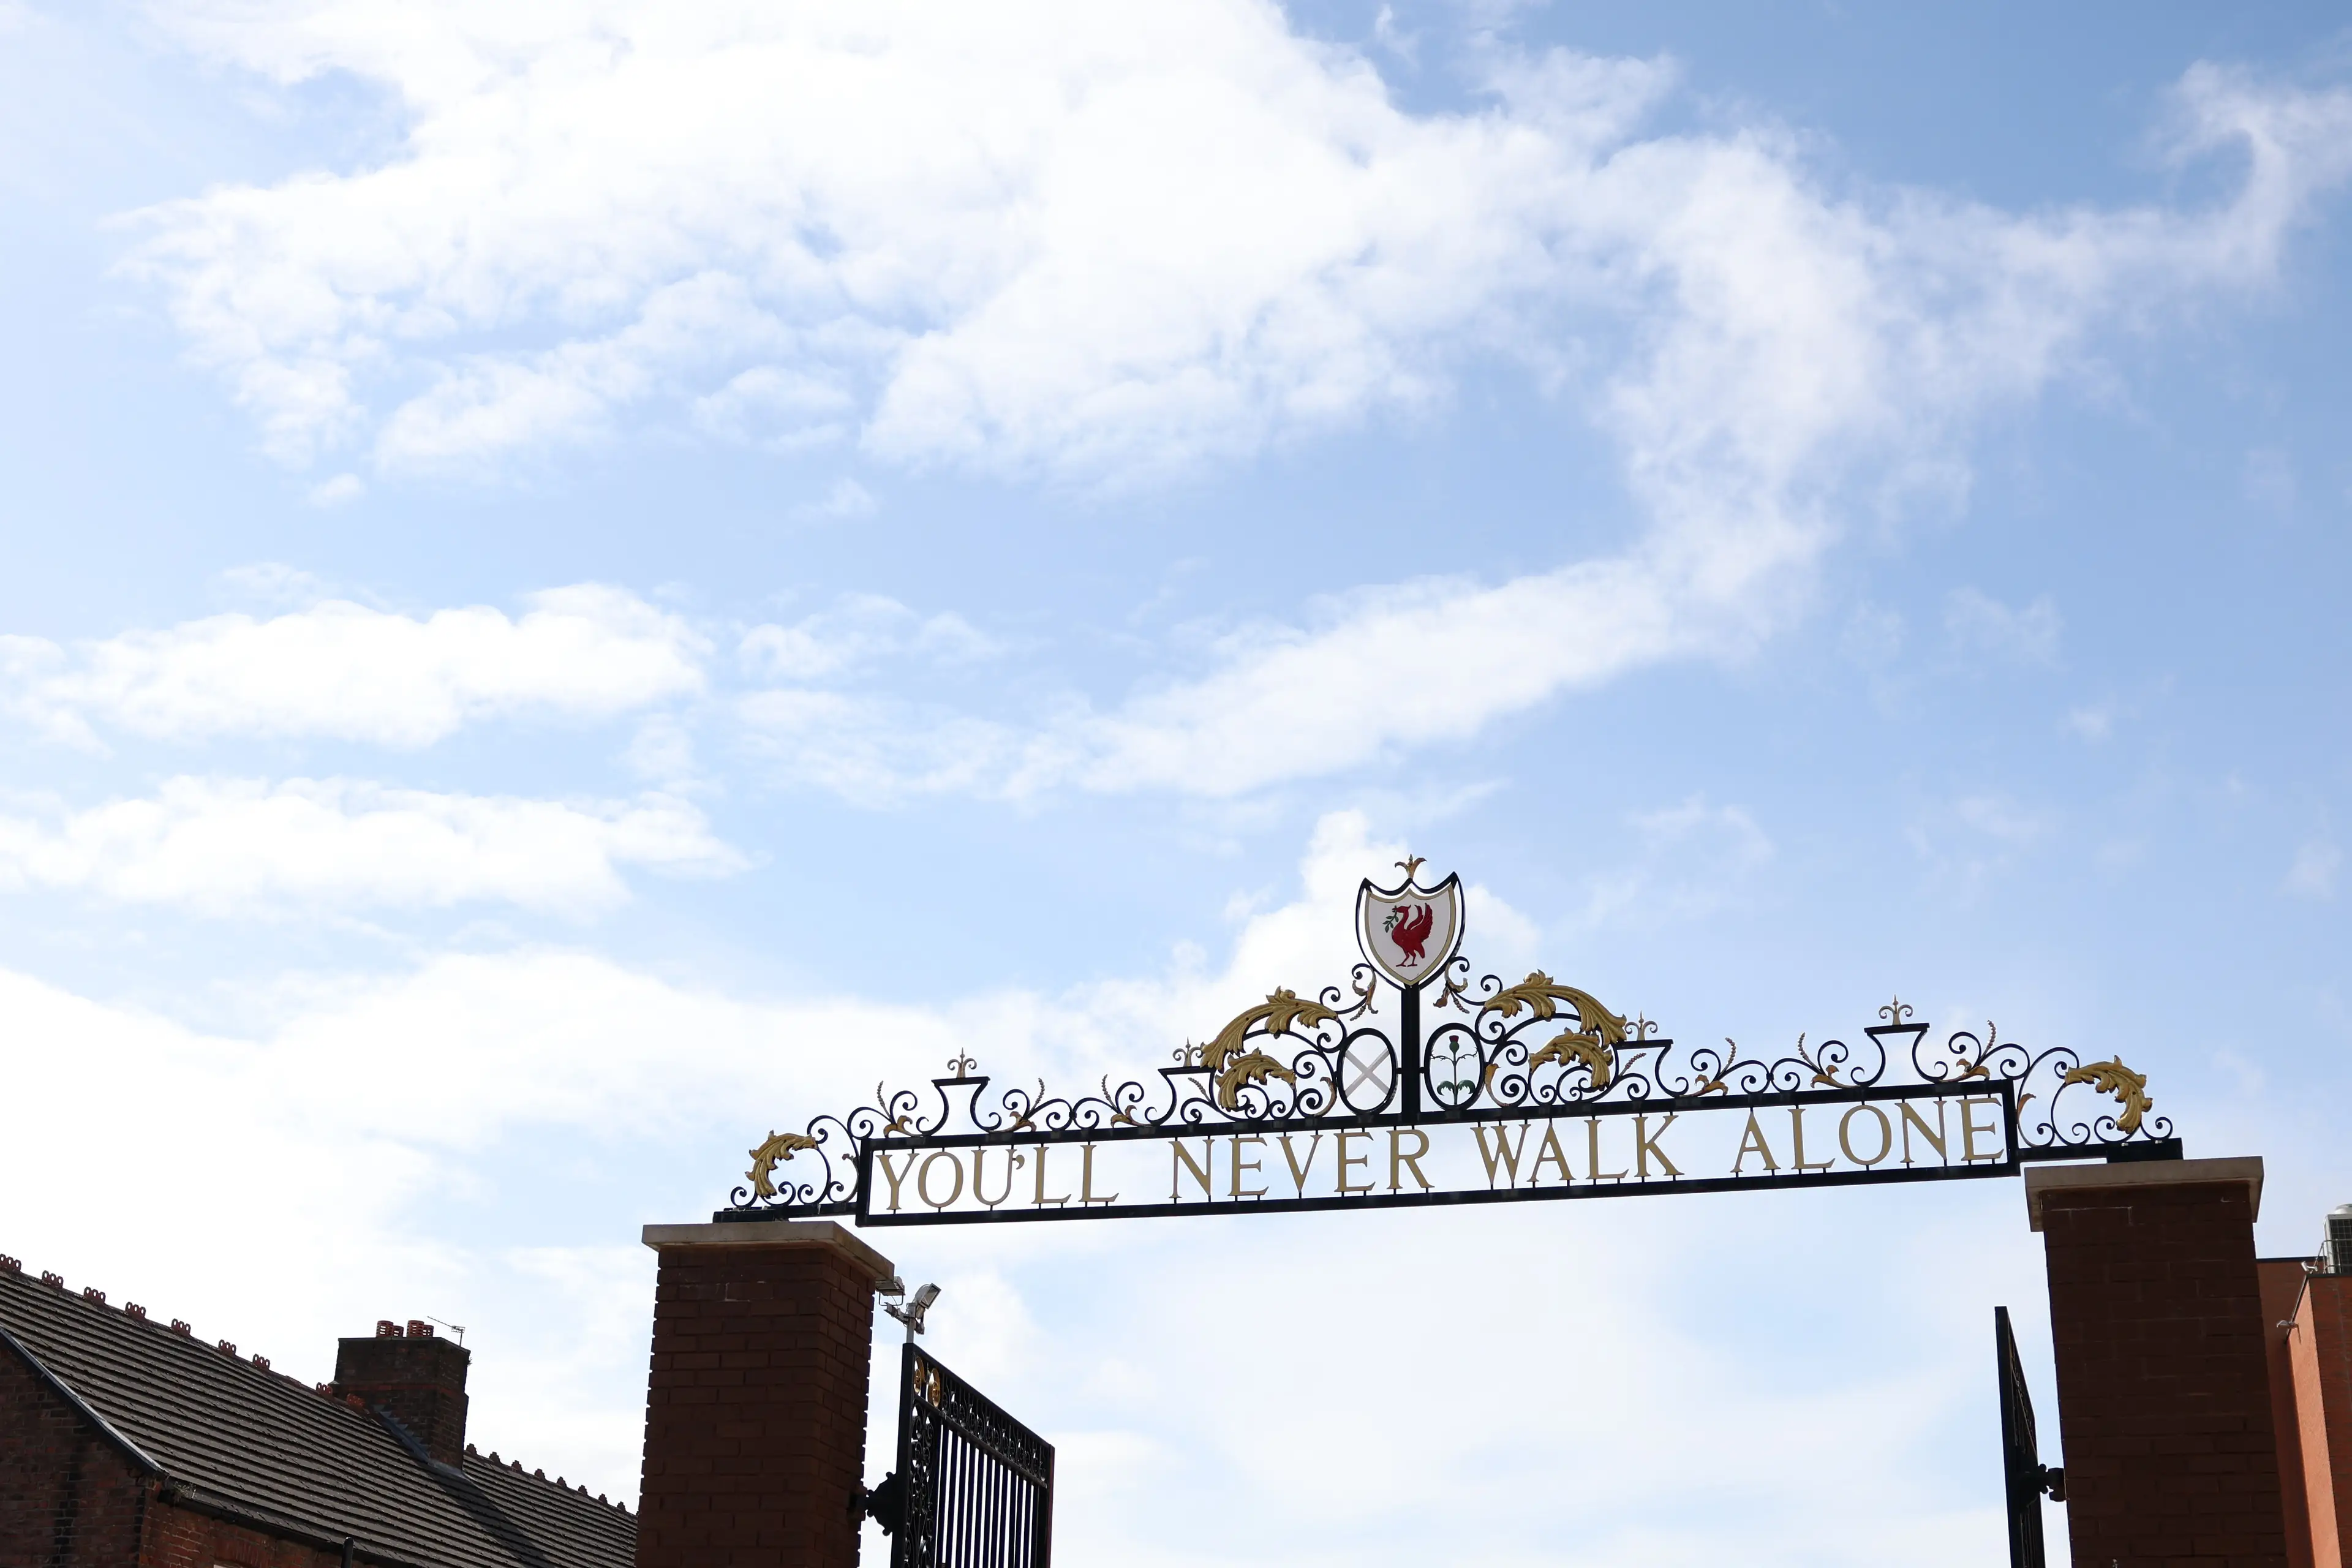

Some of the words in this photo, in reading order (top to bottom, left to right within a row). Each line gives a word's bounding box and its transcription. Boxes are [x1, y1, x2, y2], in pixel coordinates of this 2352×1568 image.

[878, 1143, 1120, 1210] YOU'LL
[1168, 1129, 1433, 1199] NEVER
[1470, 1115, 1685, 1185] WALK
[1730, 1097, 2005, 1173] ALONE
